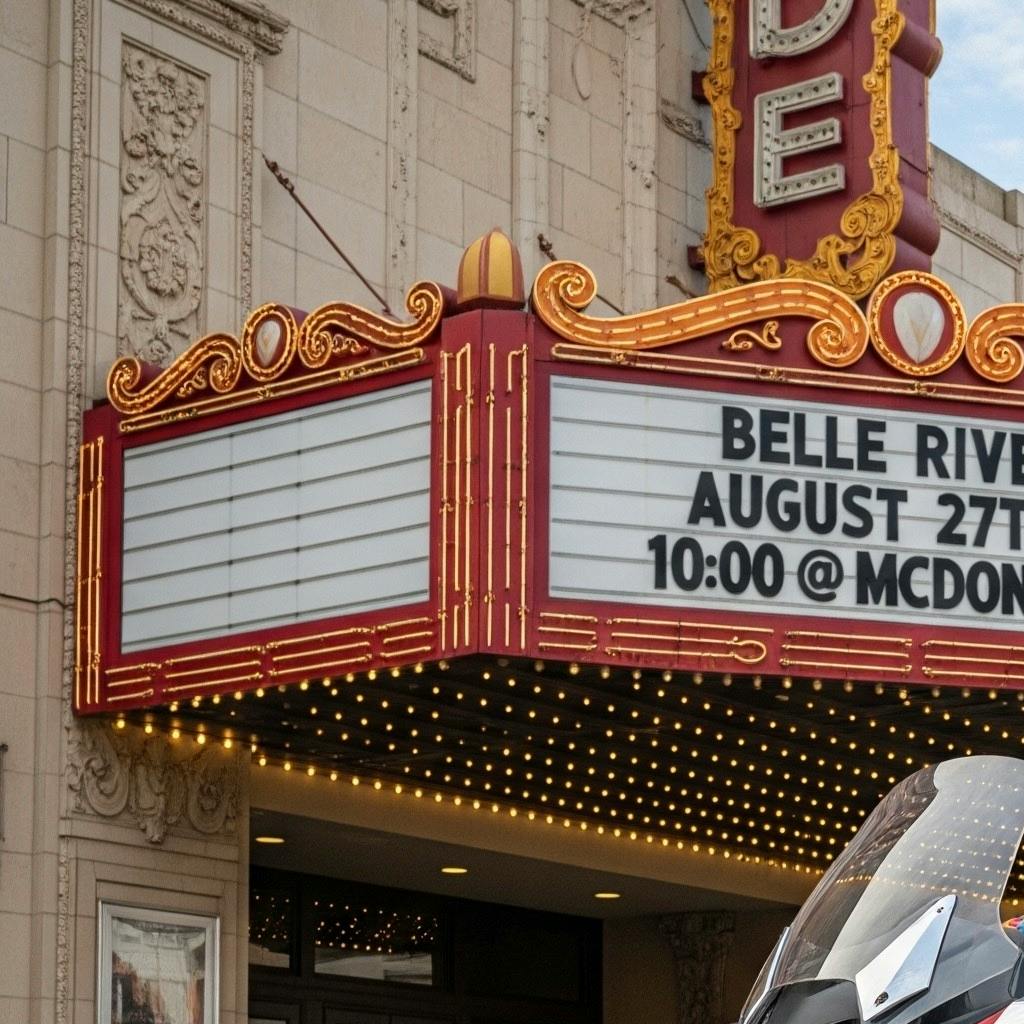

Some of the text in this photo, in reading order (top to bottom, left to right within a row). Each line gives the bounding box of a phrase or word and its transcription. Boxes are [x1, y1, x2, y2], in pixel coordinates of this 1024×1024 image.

[721, 405, 887, 473] BELLE
[687, 471, 908, 543] AUGUST
[648, 534, 785, 598] 10:00
[797, 549, 844, 602] @
